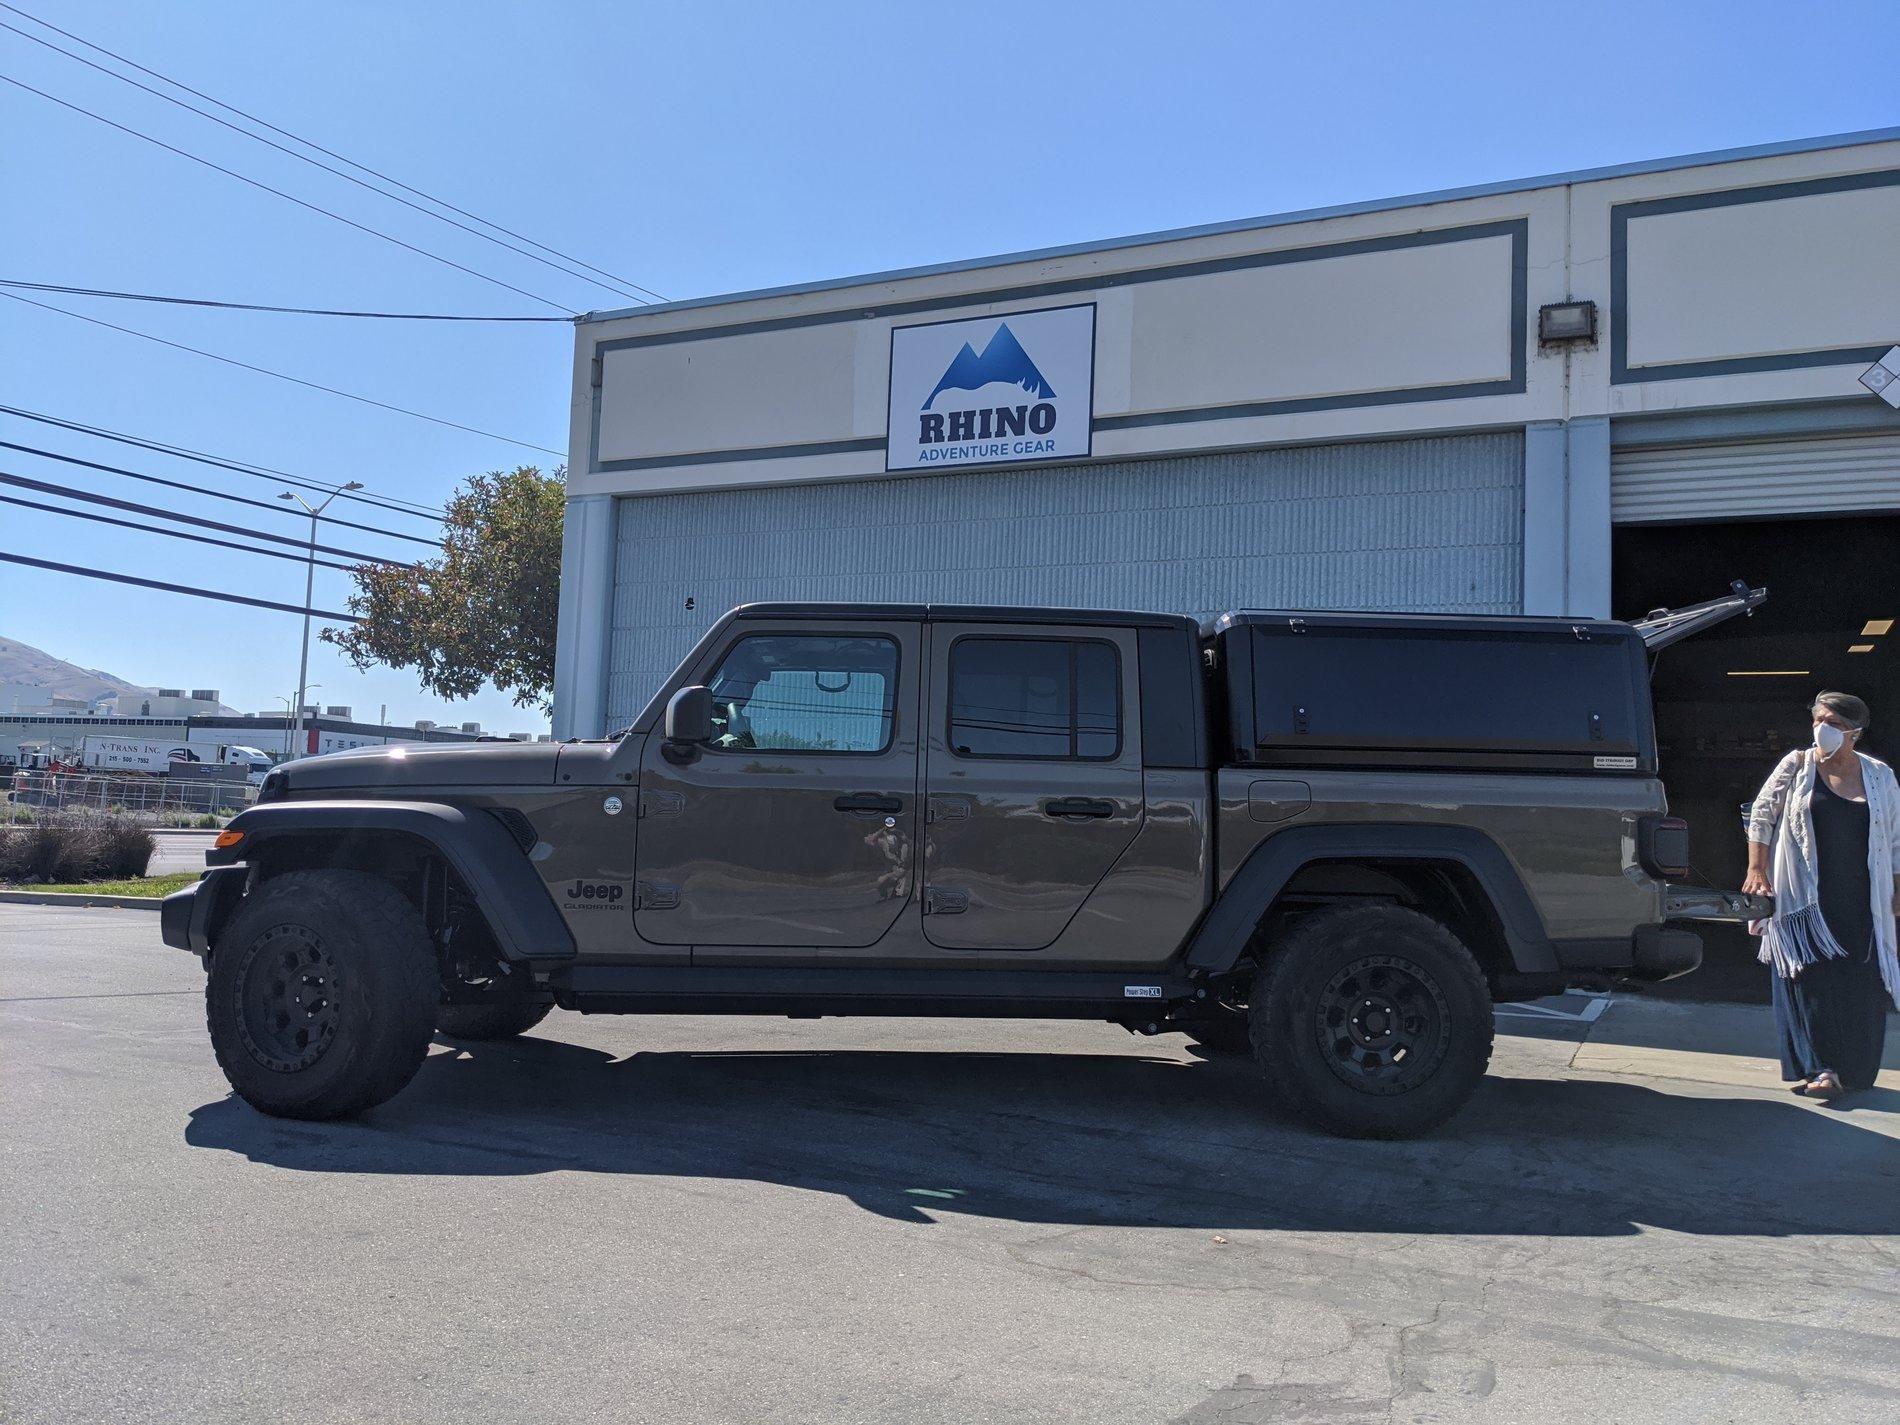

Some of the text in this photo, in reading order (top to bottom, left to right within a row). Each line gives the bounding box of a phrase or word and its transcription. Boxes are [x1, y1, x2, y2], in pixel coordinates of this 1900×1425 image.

[919, 403, 1057, 444] RHINO
[919, 439, 1055, 462] ADVENTURE GEAR
[567, 880, 623, 902] Jeep
[564, 903, 624, 911] GLADIATOR
[1149, 988, 1160, 996] XL
